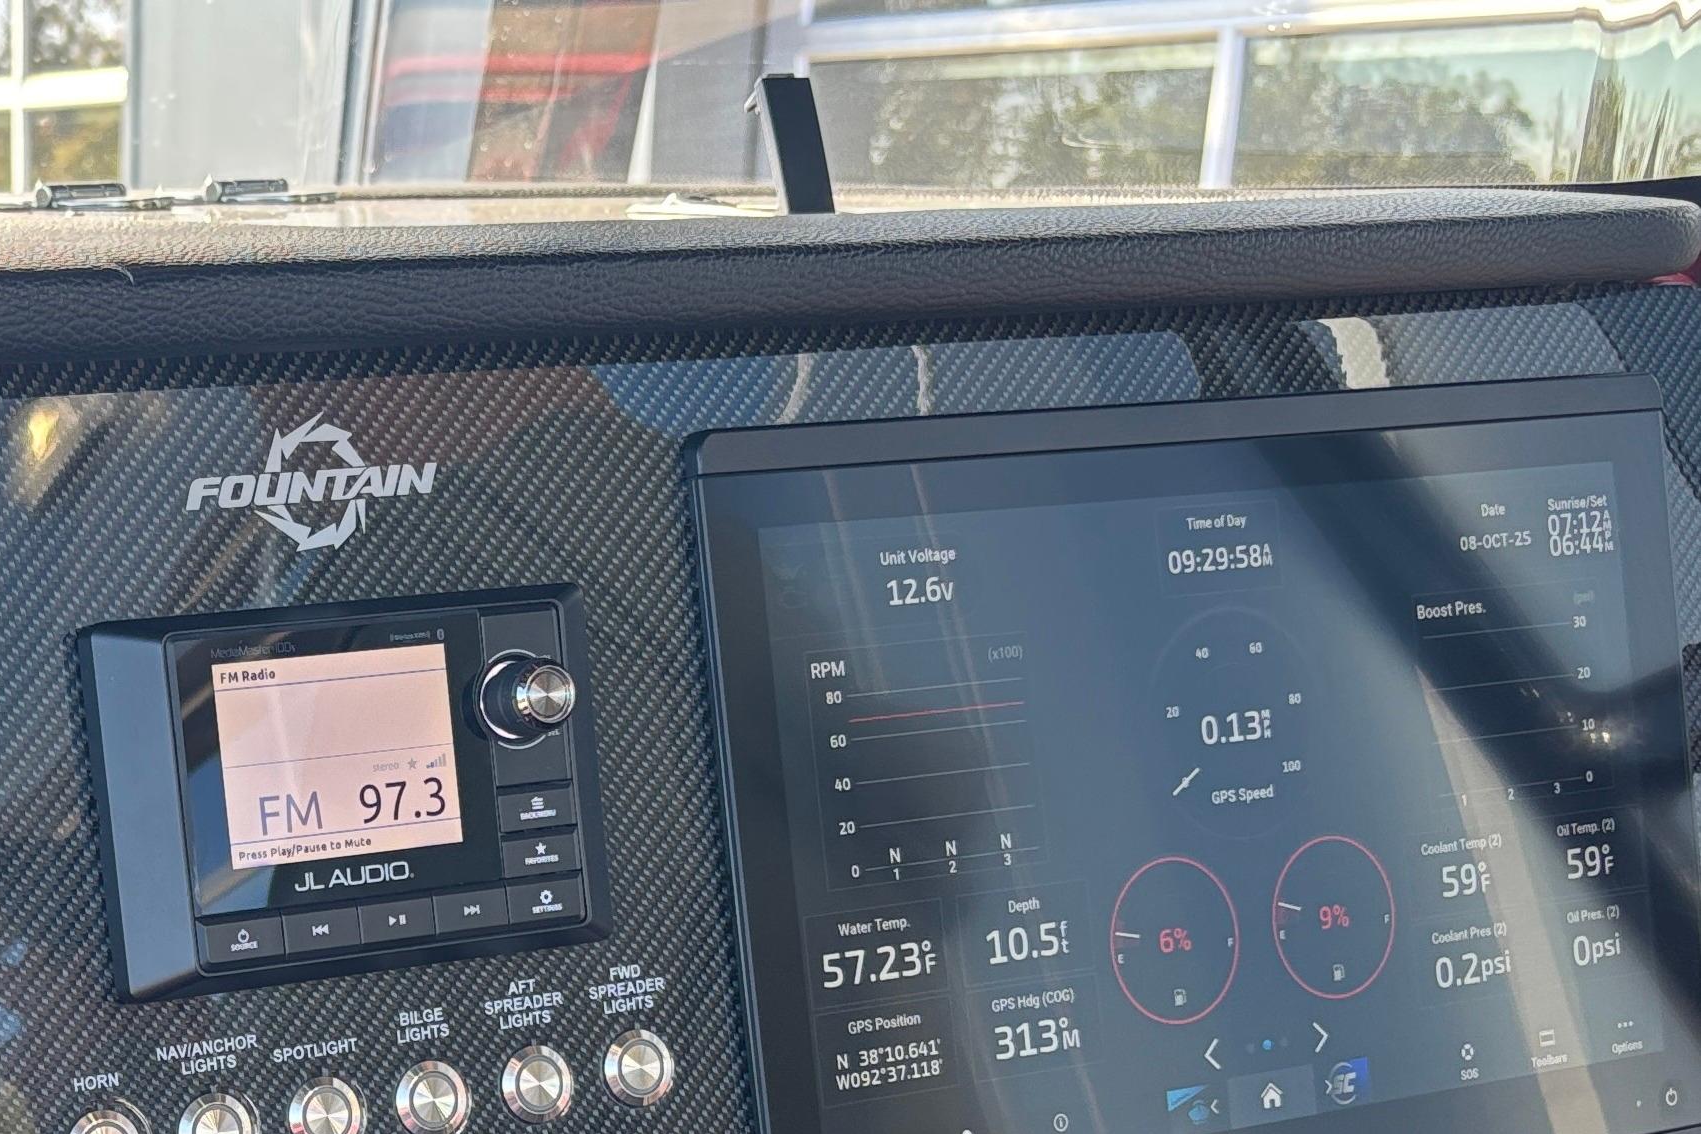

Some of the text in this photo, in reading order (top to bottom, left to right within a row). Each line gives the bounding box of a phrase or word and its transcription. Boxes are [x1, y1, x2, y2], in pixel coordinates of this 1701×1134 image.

[185, 462, 437, 512] FOUNTAIN
[1481, 503, 1505, 517] Date
[1548, 495, 1607, 511] Sunrise/Set
[1186, 514, 1247, 530] Time Day
[1548, 511, 1603, 536] 07:12
[1460, 531, 1531, 551] 08-OCT-25
[1549, 530, 1603, 557] 06:44
[880, 547, 955, 566] Unit Voltage
[1168, 545, 1262, 574] 09:29:58
[1417, 600, 1486, 620] Boost Pres.
[220, 668, 275, 683] FM Radio
[810, 661, 845, 679] RPM
[1201, 711, 1262, 744] 0.13
[372, 762, 400, 772] stereo
[1212, 784, 1274, 804] GPS Speed
[259, 777, 446, 836] FM 97.3
[1572, 820, 1599, 836] Temp.
[239, 837, 371, 861] Press Play/Pause Mute
[1421, 836, 1487, 856] Coolant Temp
[1566, 846, 1601, 880] 59
[294, 861, 410, 892] JL AUDIO
[1441, 862, 1480, 898] 59
[1008, 897, 1040, 913] Depth
[838, 916, 910, 936] Water Temp.
[1318, 905, 1349, 930] 9%
[985, 922, 1057, 965] 10.5
[1159, 928, 1191, 953] 6%
[1431, 928, 1469, 945] Coolant
[609, 963, 641, 982] FWD
[822, 941, 922, 988] 57.23
[508, 978, 535, 996] AFT
[588, 977, 664, 1000] SPREADER
[484, 991, 563, 1016] SPREADER
[602, 993, 654, 1015] LIGHTS
[991, 988, 1075, 1013] GPS Hdg (COG)
[399, 1007, 444, 1026] BILGE
[499, 1008, 551, 1030] LIGHTS
[848, 1012, 921, 1034] GPS Position
[396, 1022, 450, 1044] LIGHTS
[995, 1018, 1057, 1060] 313
[156, 1034, 258, 1062] NAV/ANCHOR
[273, 1038, 358, 1063] SPOTLIGHT
[1612, 1039, 1643, 1054] Options
[181, 1054, 237, 1075] LIGHTS
[1461, 1068, 1479, 1080] SOS
[73, 1072, 119, 1092] HORN
